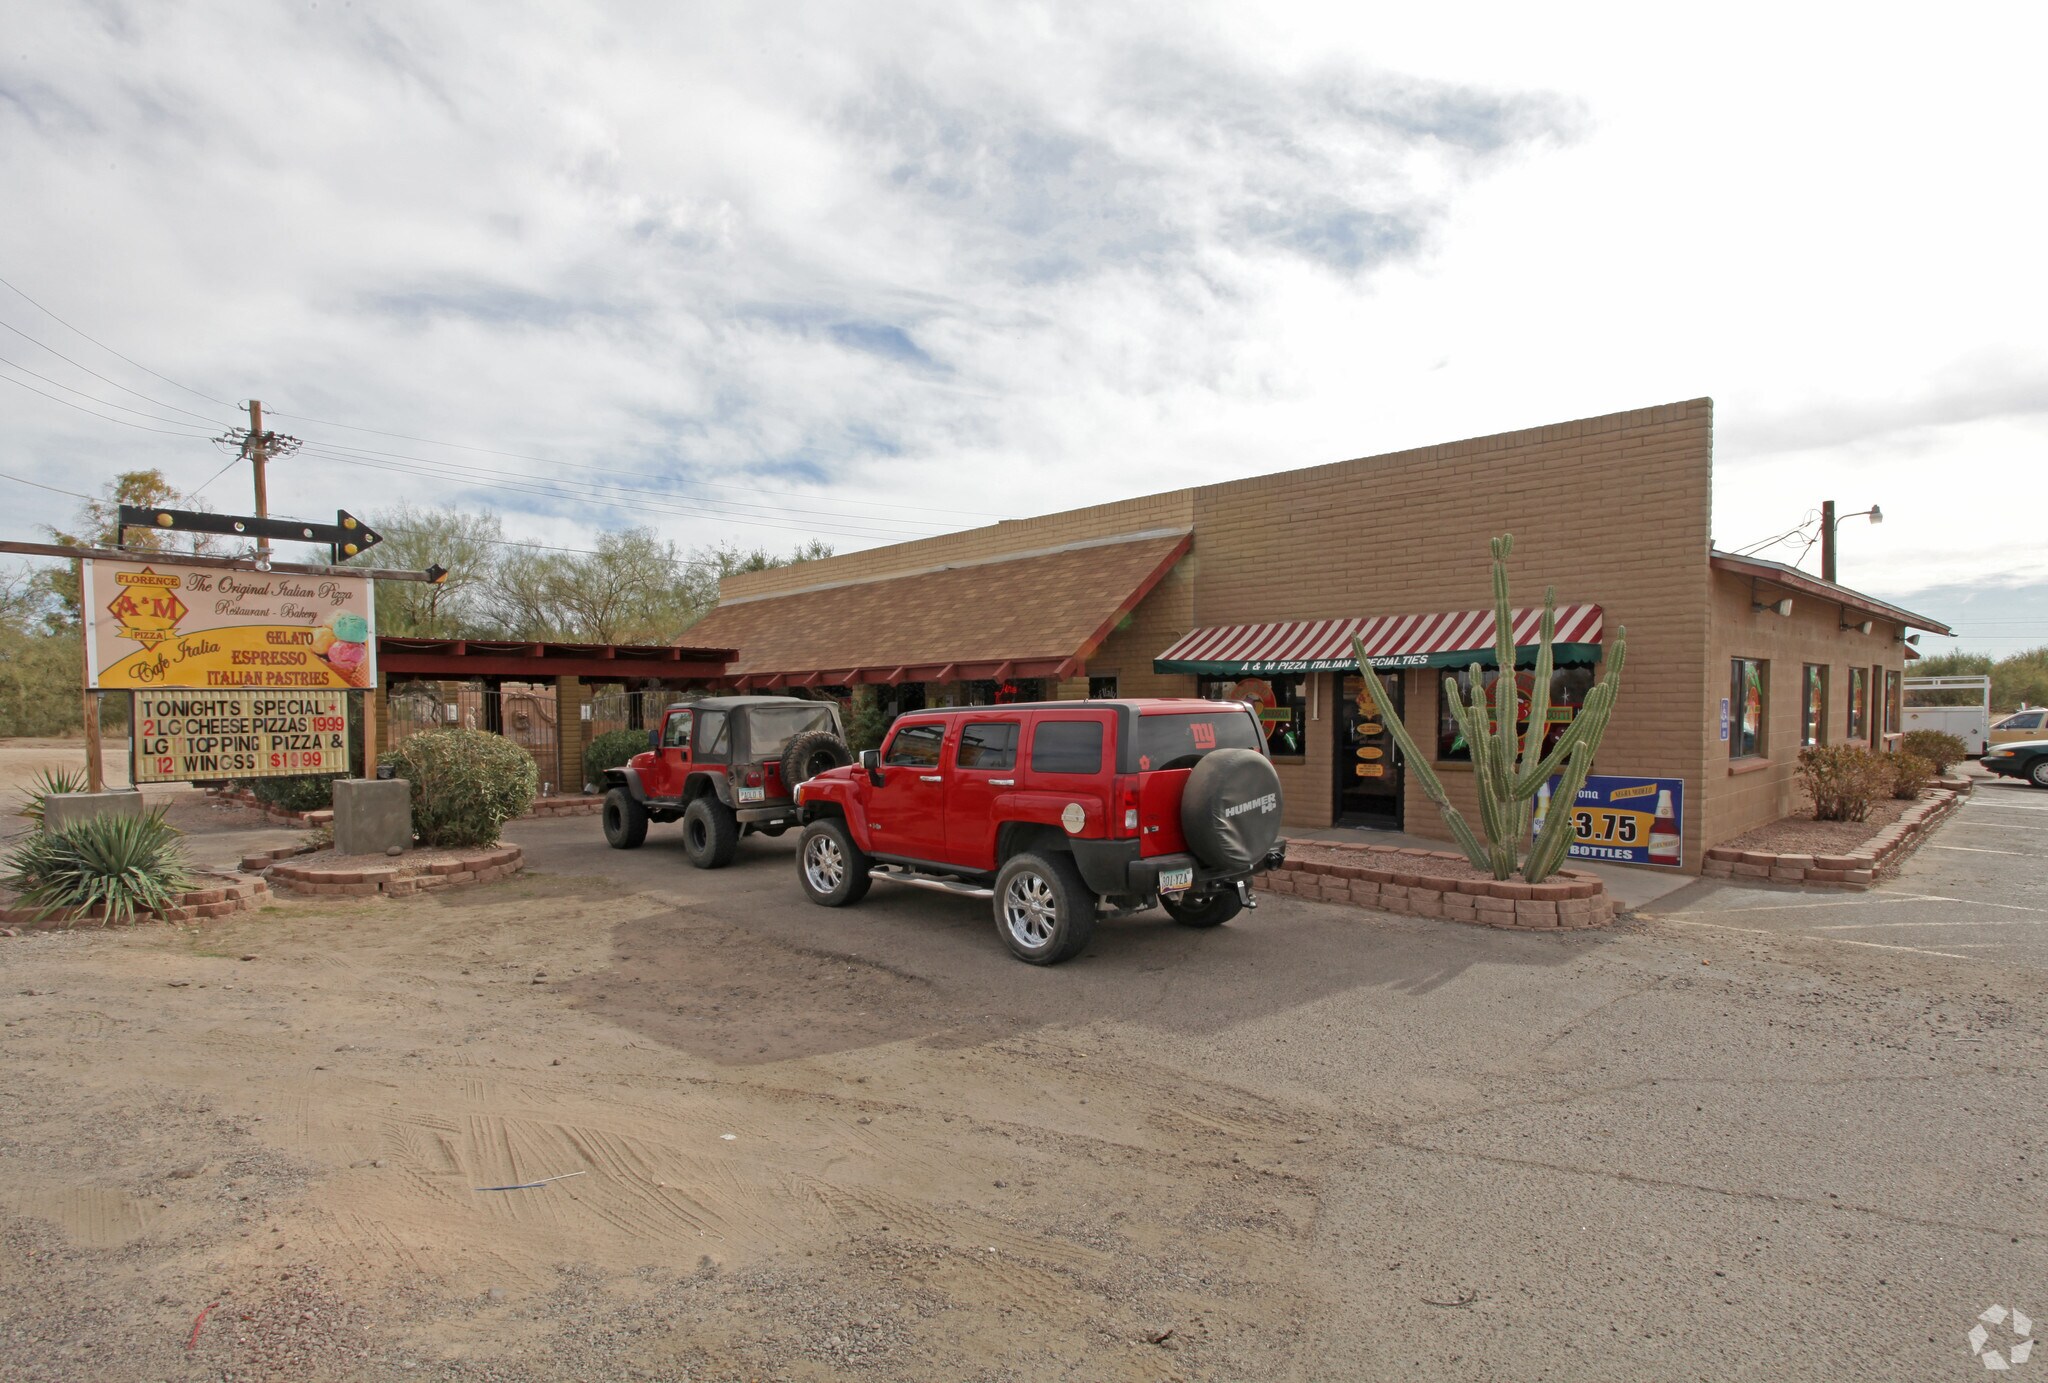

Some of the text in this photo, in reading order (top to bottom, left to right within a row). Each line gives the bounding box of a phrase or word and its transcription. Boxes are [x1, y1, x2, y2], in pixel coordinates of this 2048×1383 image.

[117, 574, 179, 587] FLORENCE
[185, 572, 353, 606] The Original Italian Pizza
[114, 595, 179, 621] A & M
[214, 599, 270, 617] Restaurant
[280, 602, 317, 624] Bakery
[134, 631, 163, 640] PIZZA
[265, 630, 314, 646] GELATO
[128, 638, 221, 683] Cafe Italia
[231, 650, 308, 666] ESPRESSO
[1241, 654, 1430, 671] A & M PIZZA ITALIAN SECIALTIES
[207, 670, 330, 687] ITALIAN PASTRIES
[143, 700, 324, 717] TONIGHTS SPECIAL
[143, 716, 345, 737] 2 LG CHEESE PIZZAS 1999
[143, 738, 169, 755] LG
[187, 736, 260, 754] TOPPING
[272, 734, 322, 751] PIZZA
[330, 733, 344, 748] &
[157, 756, 174, 774] 12
[1578, 789, 1599, 800] ona
[1225, 793, 1276, 818] HUMMER
[1569, 845, 1633, 860] BOTTLES
